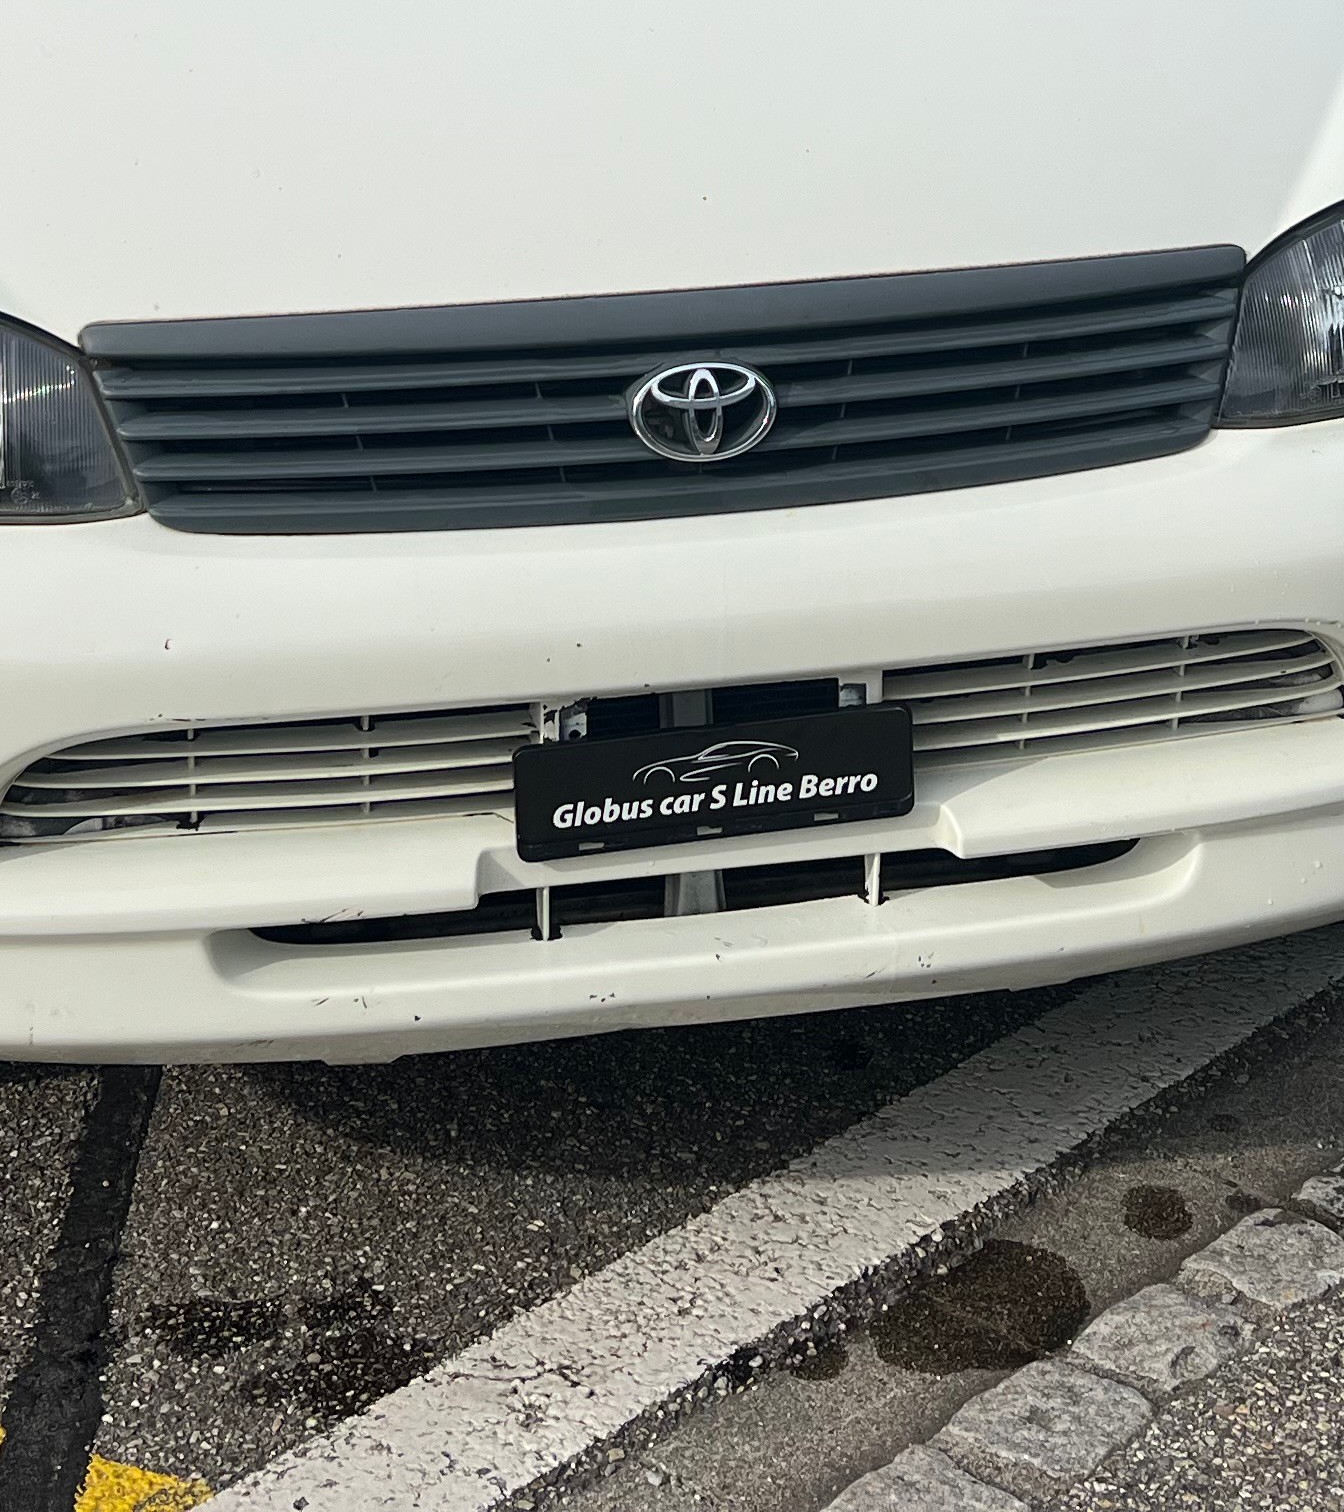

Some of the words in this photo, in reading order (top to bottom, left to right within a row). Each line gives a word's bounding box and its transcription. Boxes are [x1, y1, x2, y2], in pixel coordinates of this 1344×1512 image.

[552, 798, 654, 829] Globus
[659, 791, 706, 816] car
[709, 784, 727, 810] S
[732, 779, 793, 808] Line
[798, 772, 879, 800] Berro
